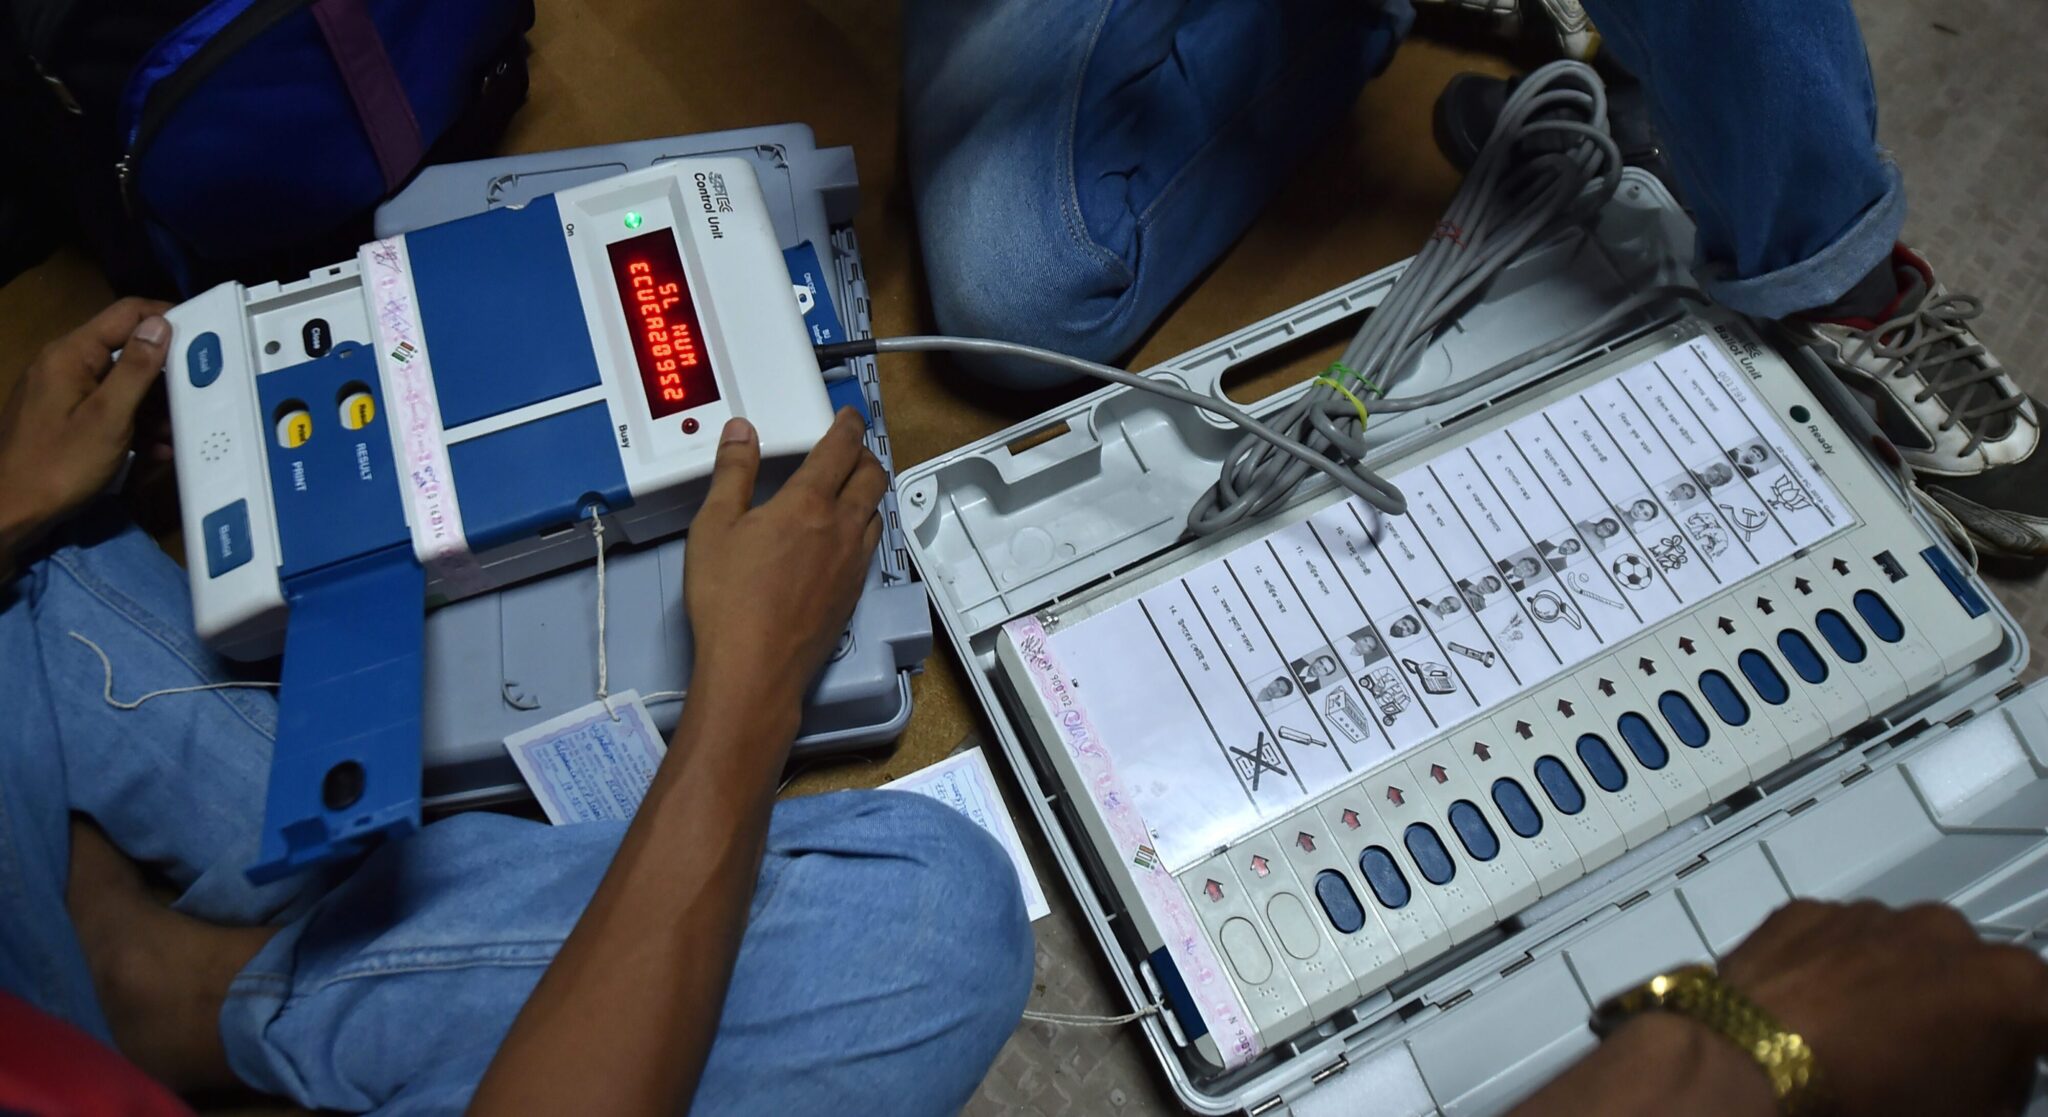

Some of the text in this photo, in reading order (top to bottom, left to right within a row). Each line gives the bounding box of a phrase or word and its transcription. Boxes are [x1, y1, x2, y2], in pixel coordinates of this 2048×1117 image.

[694, 173, 723, 239] Control Unit
[566, 223, 575, 237] On
[312, 328, 320, 349] Close
[657, 283, 697, 366] SL NUM
[199, 348, 210, 372] Total
[1714, 325, 1762, 382] Ballot Unit
[619, 424, 629, 448] Busy
[1808, 425, 1835, 454] Ready
[292, 461, 306, 490] PRINT
[356, 443, 372, 480] RESULT
[219, 525, 232, 557] Ballot
